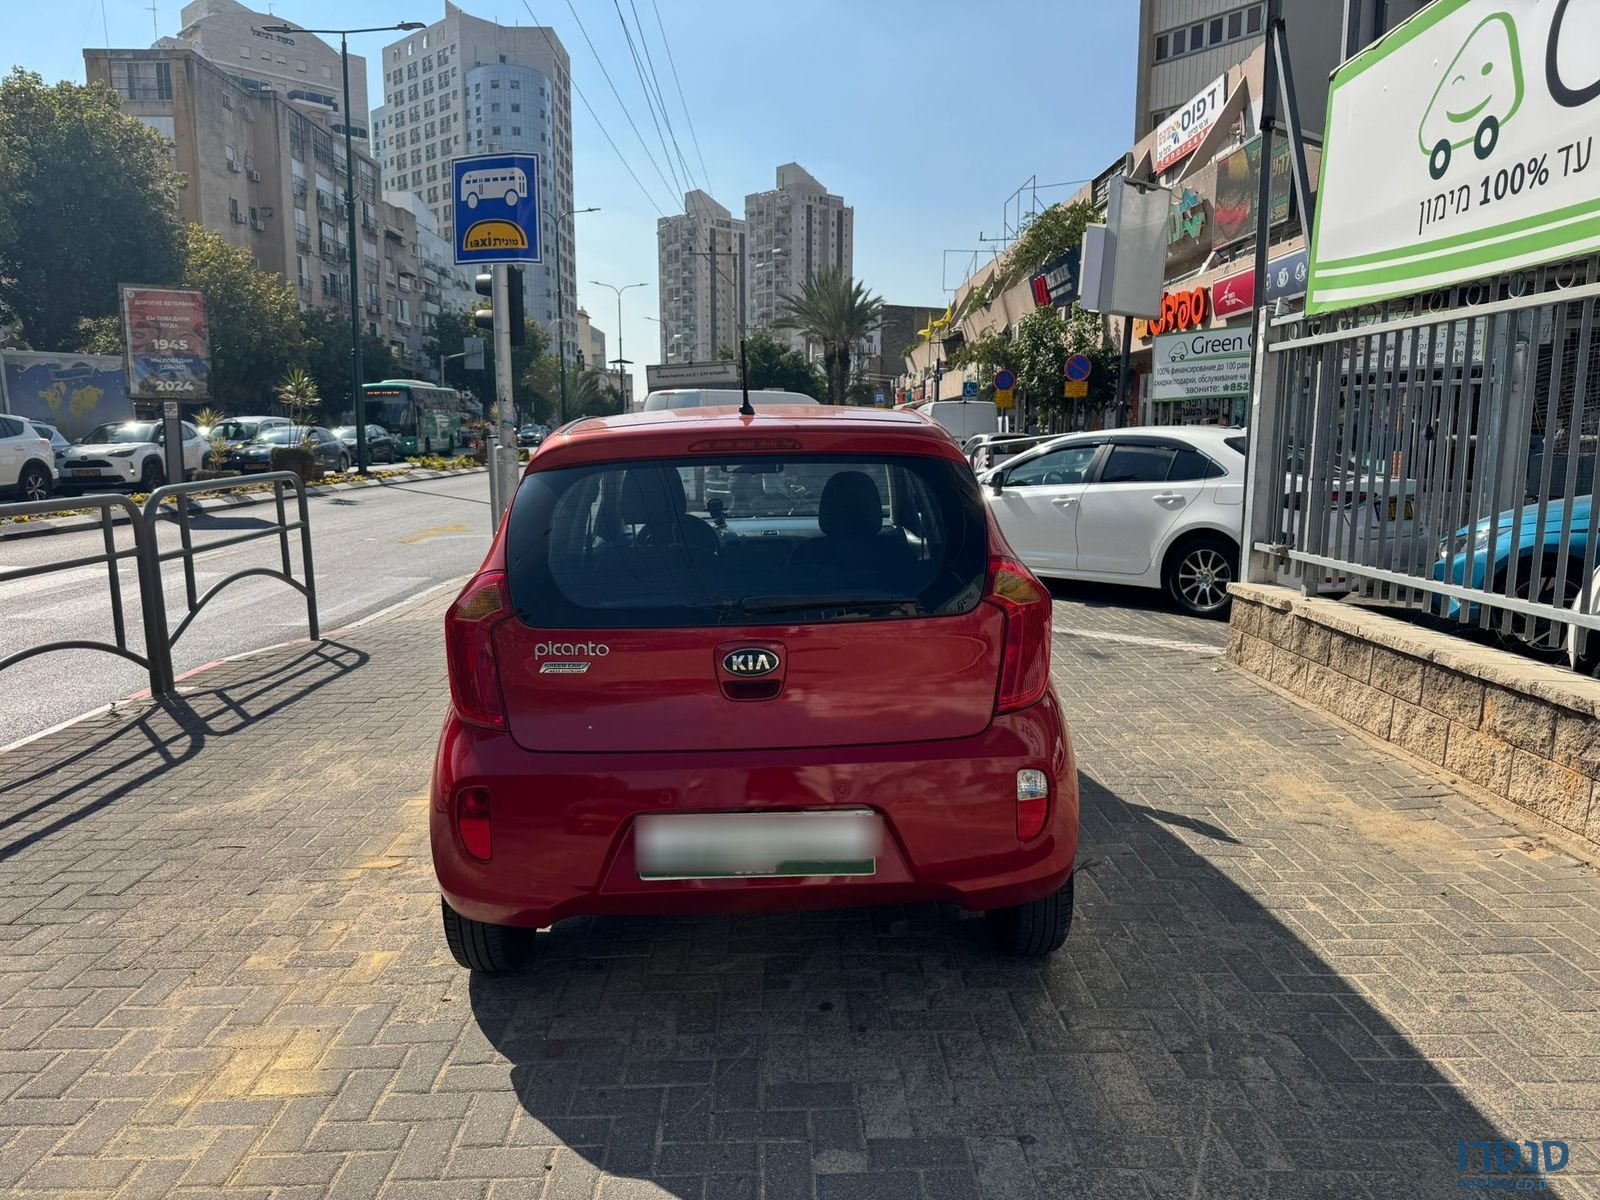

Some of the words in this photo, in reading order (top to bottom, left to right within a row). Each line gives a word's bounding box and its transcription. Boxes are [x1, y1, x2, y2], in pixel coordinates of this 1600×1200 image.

[1181, 87, 1217, 132] דפוס
[1557, 136, 1593, 177] עד
[1478, 152, 1549, 207] 100%
[1418, 184, 1470, 236] מימון
[470, 231, 492, 248] taxi
[493, 237, 518, 247] מונית
[151, 339, 189, 350] 1945
[1191, 336, 1242, 355] Green
[1156, 366, 1170, 376] 100%
[1171, 364, 1216, 377] финансирование
[1226, 361, 1236, 370] 100
[156, 380, 194, 391] 2024
[1185, 385, 1220, 394] звоните:
[534, 640, 610, 661] picanto
[730, 653, 773, 672] KIA
